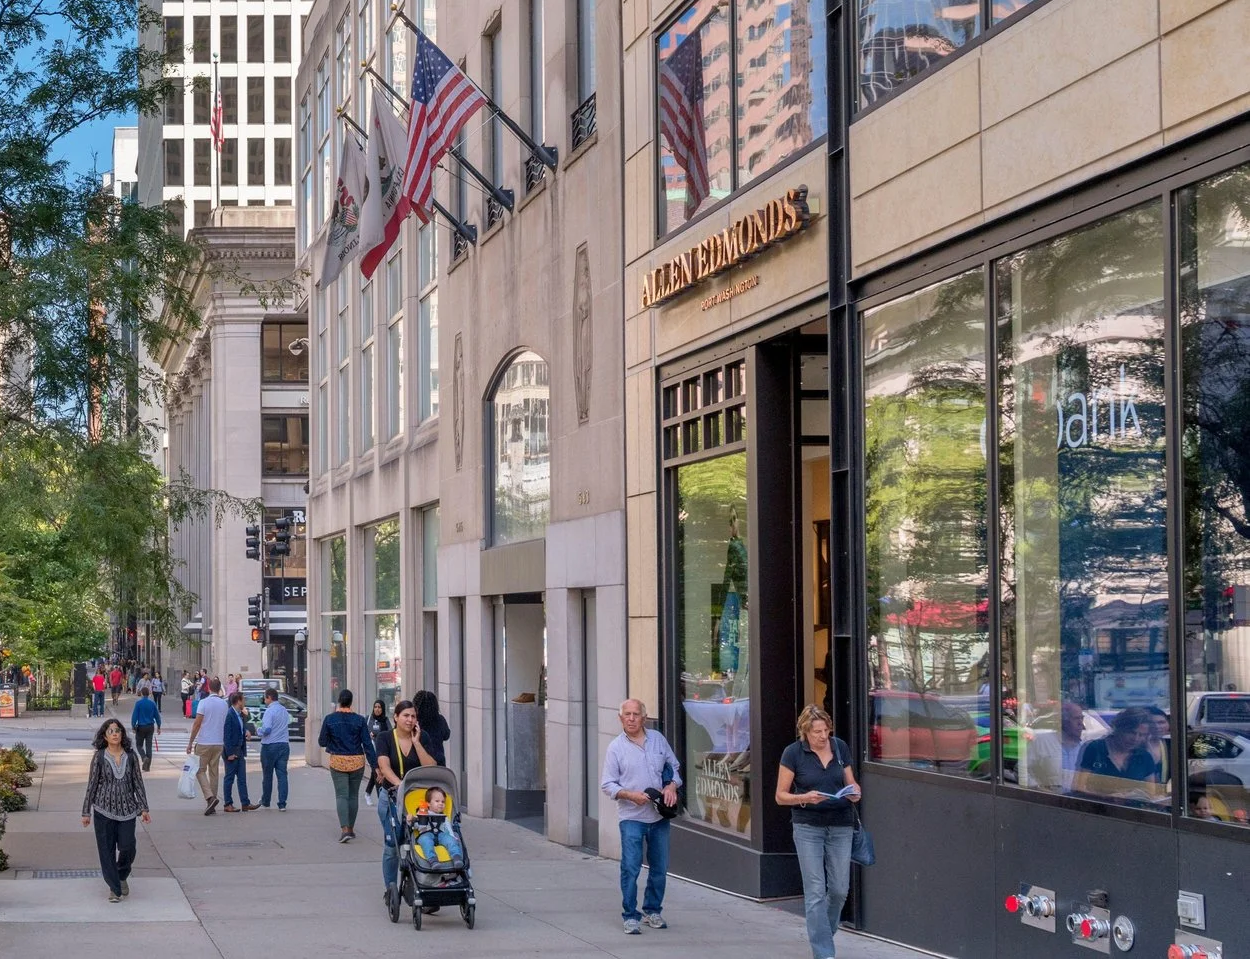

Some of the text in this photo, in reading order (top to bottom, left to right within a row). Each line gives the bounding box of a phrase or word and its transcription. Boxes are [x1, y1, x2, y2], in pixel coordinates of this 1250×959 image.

[641, 188, 801, 309] ALLEN EDMONDS
[701, 298, 716, 312] PORT
[284, 586, 308, 597] SEP
[702, 758, 731, 781] ALLEN
[696, 776, 740, 804] EDMONDS
